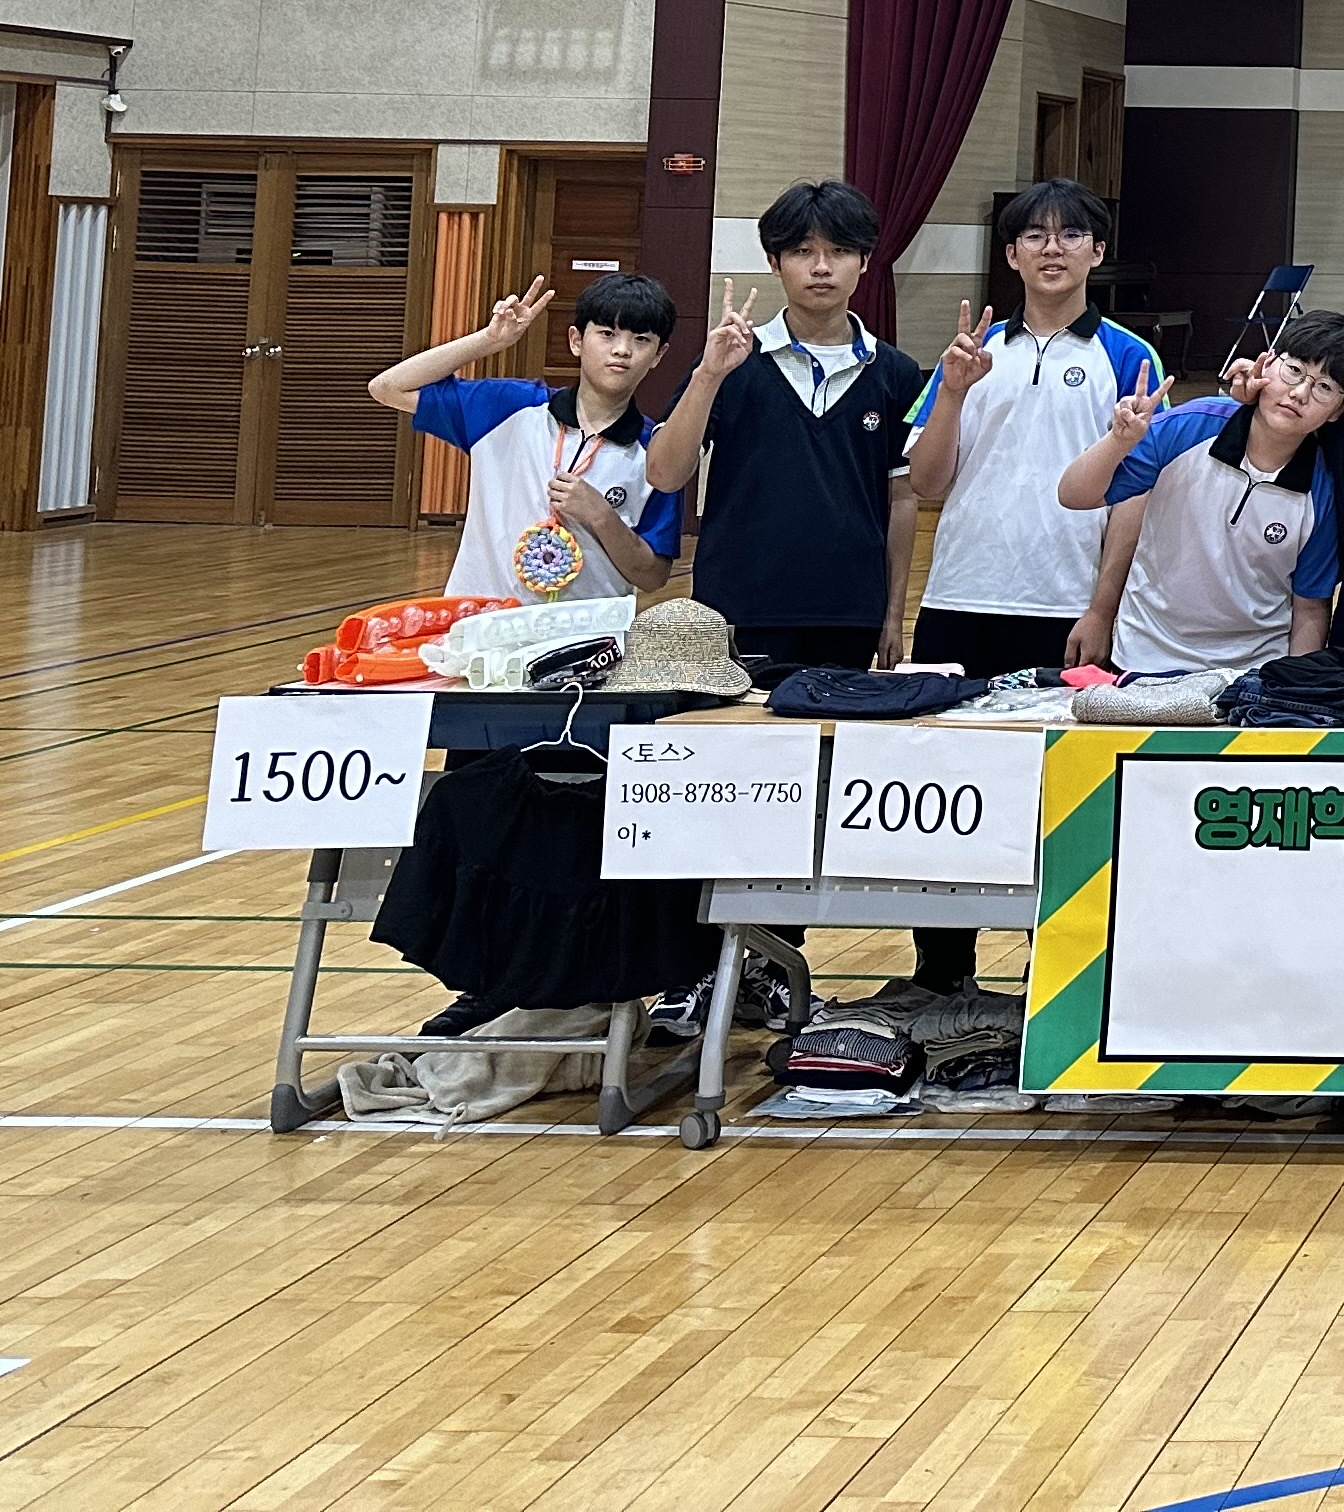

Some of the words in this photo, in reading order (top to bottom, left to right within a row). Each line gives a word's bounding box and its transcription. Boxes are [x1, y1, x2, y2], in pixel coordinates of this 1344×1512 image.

[621, 742, 696, 763] <토스>
[231, 749, 407, 804] 1500~
[620, 782, 802, 804] 1908-8783-7750
[840, 778, 984, 836] 2000
